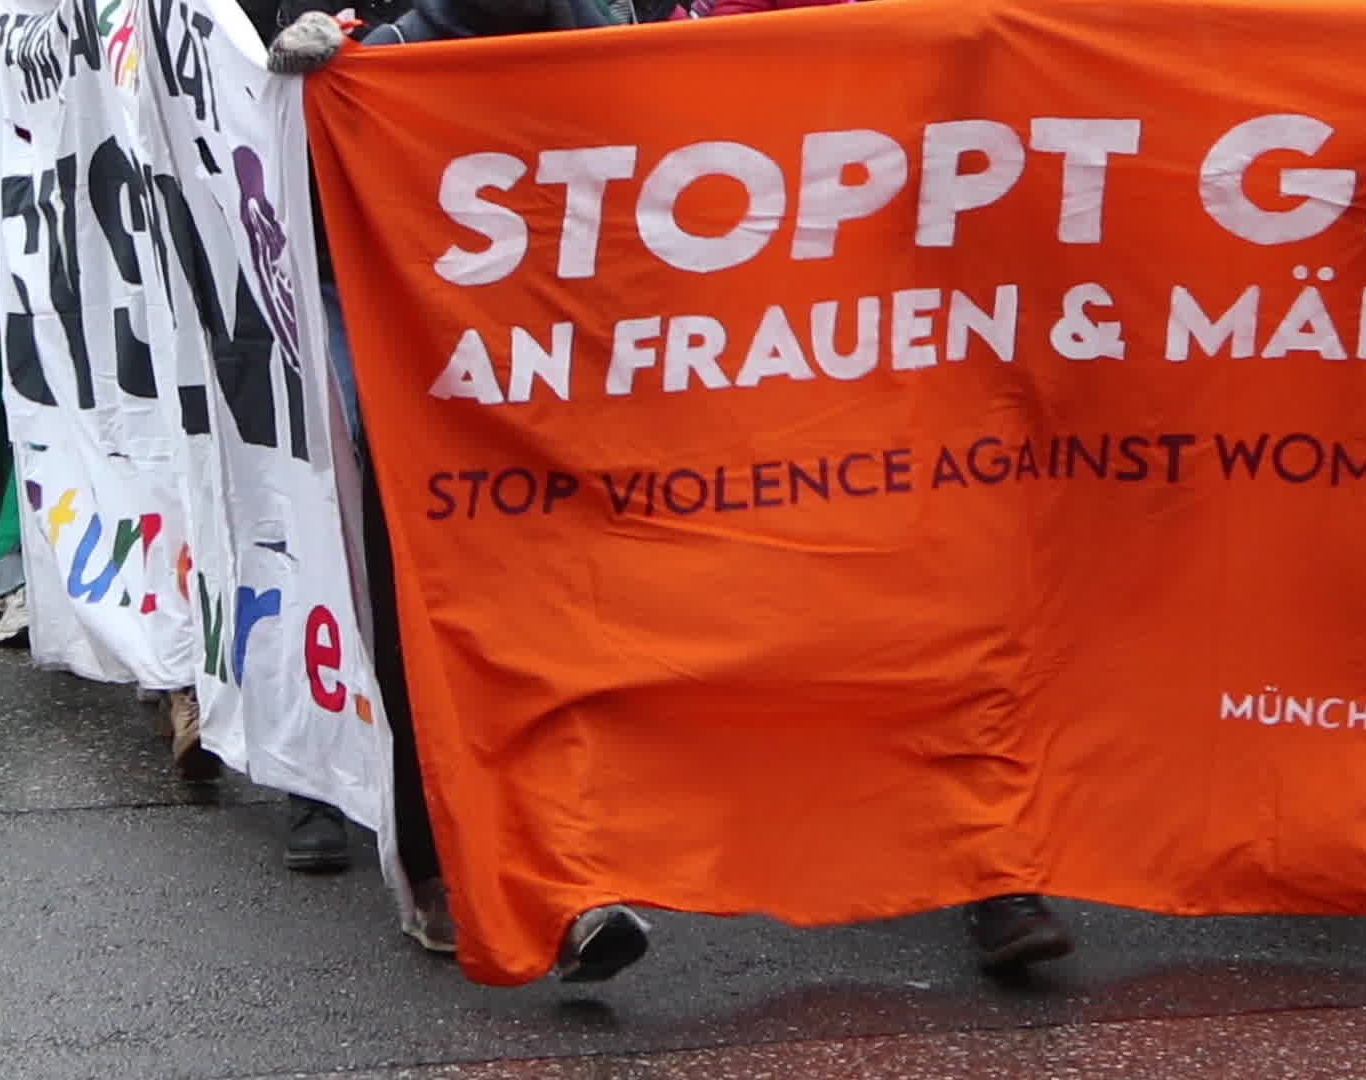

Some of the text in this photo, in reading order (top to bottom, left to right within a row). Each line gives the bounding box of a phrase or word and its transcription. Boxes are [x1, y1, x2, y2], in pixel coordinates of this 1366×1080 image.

[434, 117, 1142, 287] STOPPT
[428, 321, 574, 406] AN
[604, 283, 1019, 396] FRAUEN
[1049, 282, 1126, 361] &
[427, 465, 580, 521] STOP
[601, 447, 914, 517] VIOLENCE
[932, 433, 1197, 490] AGAINST
